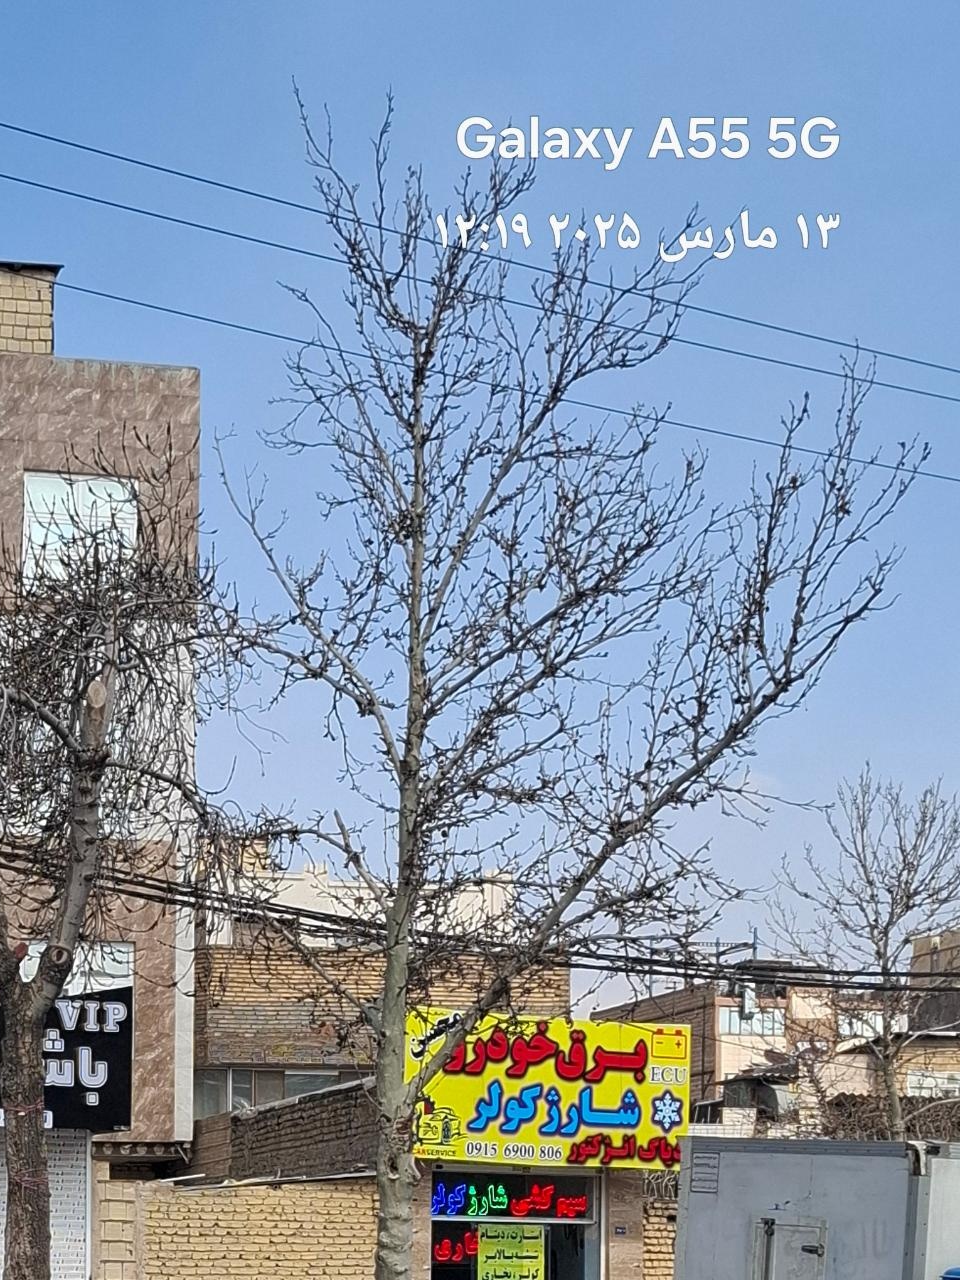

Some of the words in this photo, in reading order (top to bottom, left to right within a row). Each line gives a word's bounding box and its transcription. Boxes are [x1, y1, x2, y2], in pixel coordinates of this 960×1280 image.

[55, 999, 128, 1033] VIP
[443, 1021, 558, 1079] خودرو
[554, 1028, 648, 1084] برق
[650, 1066, 687, 1084] ECU
[466, 1079, 542, 1133] کولر
[539, 1085, 642, 1136] شارژ
[466, 1141, 497, 1157] 0915
[504, 1142, 535, 1158] 6900
[539, 1144, 563, 1160] 806
[566, 1133, 635, 1165] انژکتور
[430, 1183, 466, 1216] کولر
[468, 1184, 508, 1216] شارژ
[510, 1183, 554, 1216] کشی
[556, 1195, 587, 1217] سیم
